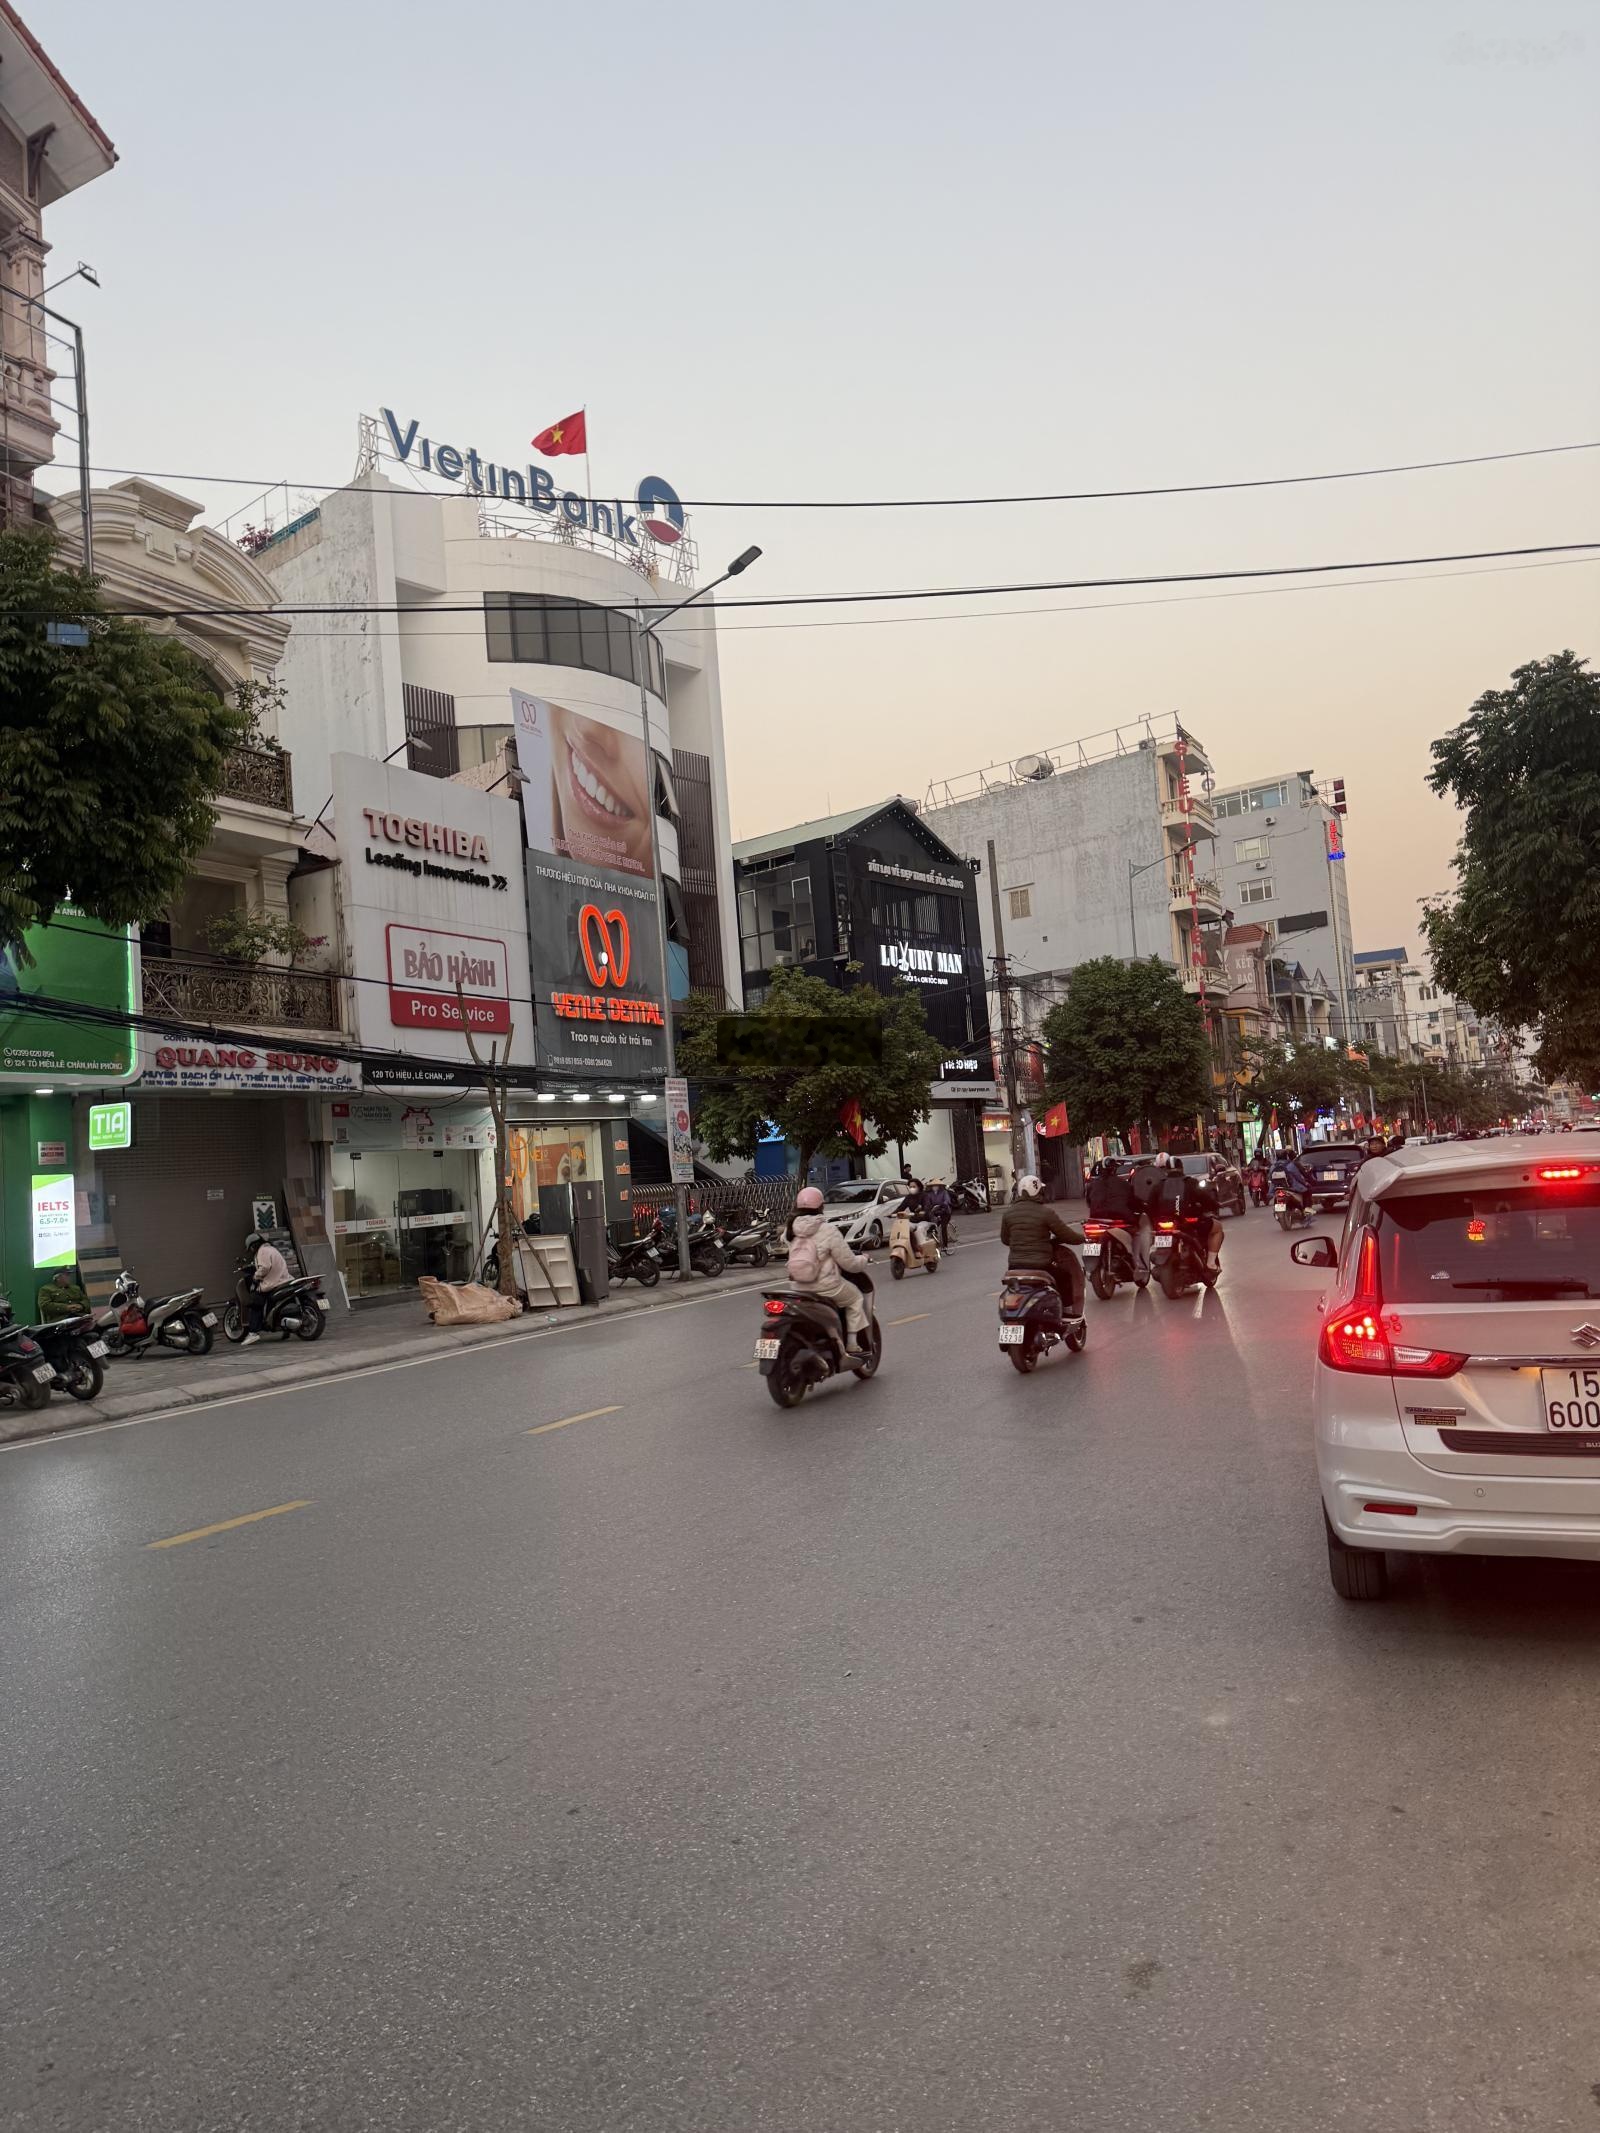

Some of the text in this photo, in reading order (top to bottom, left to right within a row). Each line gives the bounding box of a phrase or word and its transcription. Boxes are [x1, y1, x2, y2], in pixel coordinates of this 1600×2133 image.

[379, 407, 639, 547] VietinBank
[363, 808, 490, 863] TOSHIBA
[366, 848, 490, 887] Leading Innovation
[404, 941, 496, 987] BẢO HÀNH
[937, 952, 963, 974] MAN
[411, 1000, 437, 1017] Pro
[570, 1031, 588, 1043] Trao
[589, 1034, 599, 1046] nụ
[641, 1036, 653, 1046] tim
[155, 1047, 257, 1070] QUANG
[371, 1070, 384, 1079] 120
[385, 1068, 395, 1079] TÔ
[94, 1111, 124, 1134] TIA
[37, 1200, 70, 1212] IELTS
